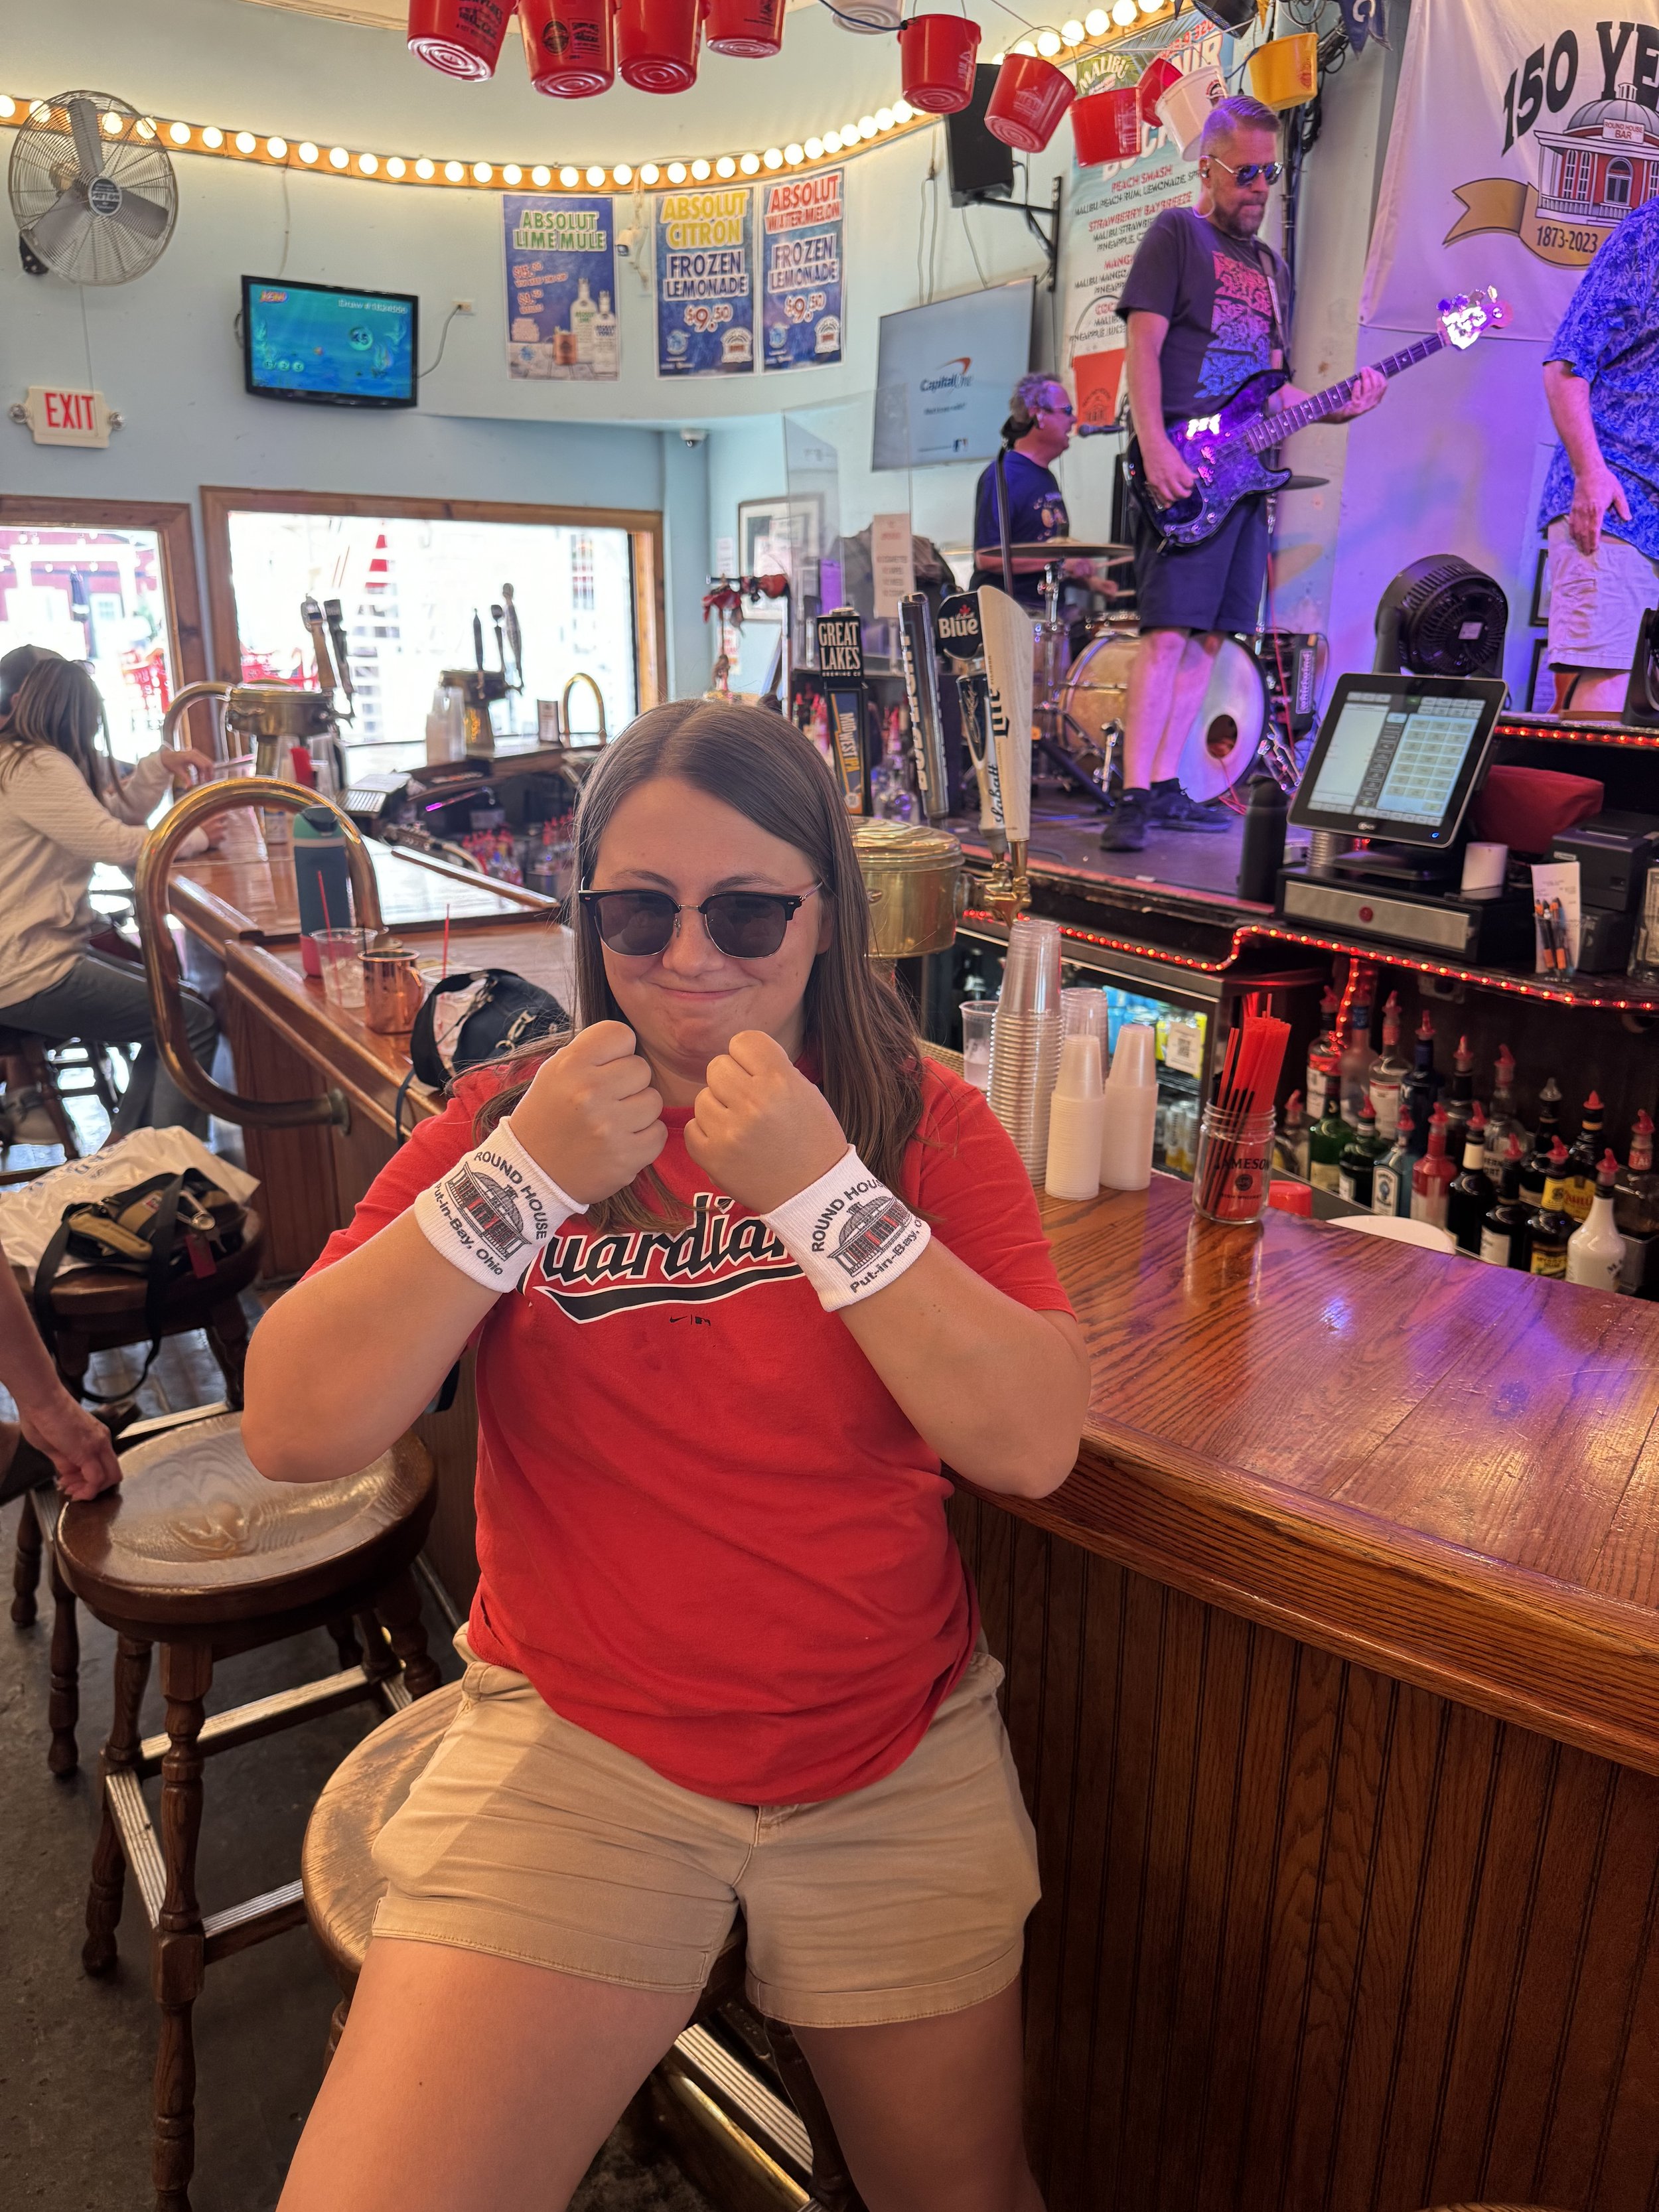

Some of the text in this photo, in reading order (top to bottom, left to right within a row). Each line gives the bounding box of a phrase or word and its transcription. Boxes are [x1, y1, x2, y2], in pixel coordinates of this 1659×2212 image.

[1078, 54, 1129, 94] MALIBU
[1501, 29, 1579, 157] 150
[1604, 120, 1644, 133] ROUND HOUSE
[1615, 129, 1632, 141] BAR
[1112, 165, 1173, 192] PEACH SMASH
[663, 191, 747, 221] ABSOLUT
[770, 175, 839, 213] ABSOLUT
[1074, 204, 1099, 216] MALIBU
[1100, 195, 1123, 208] PEACH
[1143, 174, 1187, 195] LEMONADE
[522, 211, 597, 230] ABSOLUT
[766, 202, 840, 233] WATERMELON
[1088, 206, 1143, 232] STRAWBERRY
[516, 232, 605, 250] LIME MULE
[669, 219, 741, 248] CITRON
[1093, 228, 1118, 242] MALIBU
[1537, 225, 1599, 254] 1873-2023
[670, 252, 741, 277] FROZEN
[775, 235, 833, 268] FROZEN
[1104, 254, 1133, 269] MANG
[667, 276, 745, 297] LEMONADE
[771, 261, 836, 290] LEMONADE
[1074, 276, 1098, 289] MALIBU
[686, 306, 731, 330] $9.50
[44, 392, 94, 431] EXIT
[818, 621, 859, 646] GREAT
[938, 617, 979, 638] Blue
[820, 646, 861, 670] LAKES
[838, 713, 861, 773] MIDWEST IPA
[474, 1151, 548, 1240] ROUND HOUSE
[539, 1192, 788, 1286] uardia
[812, 1199, 845, 1252] ROUND
[476, 1248, 503, 1276] Ohio
[849, 1230, 920, 1293] Put-in-Bay,
